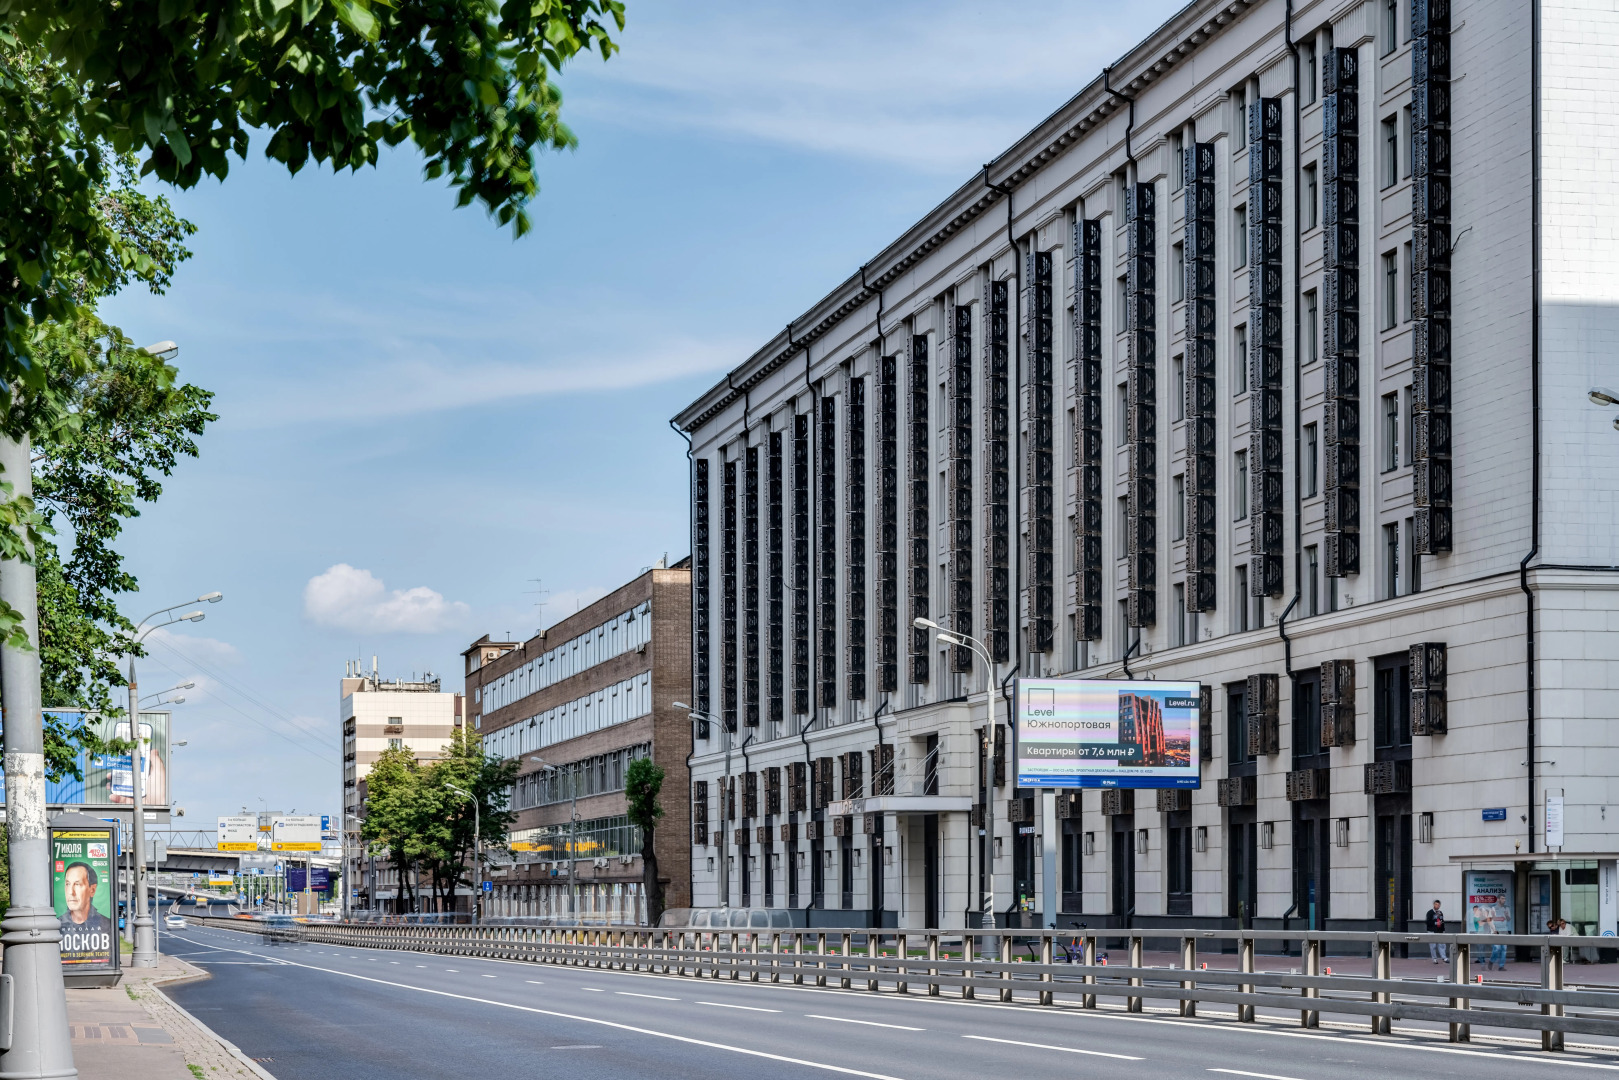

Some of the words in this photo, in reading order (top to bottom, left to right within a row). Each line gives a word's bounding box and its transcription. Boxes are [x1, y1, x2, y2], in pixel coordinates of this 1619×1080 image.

[1028, 704, 1055, 717] Level
[1027, 719, 1111, 731] Южнопортовая
[1027, 746, 1076, 756] Квартиры
[1092, 747, 1105, 758] 7,6
[55, 842, 60, 858] 7
[61, 843, 82, 854] ИЮЛЯ
